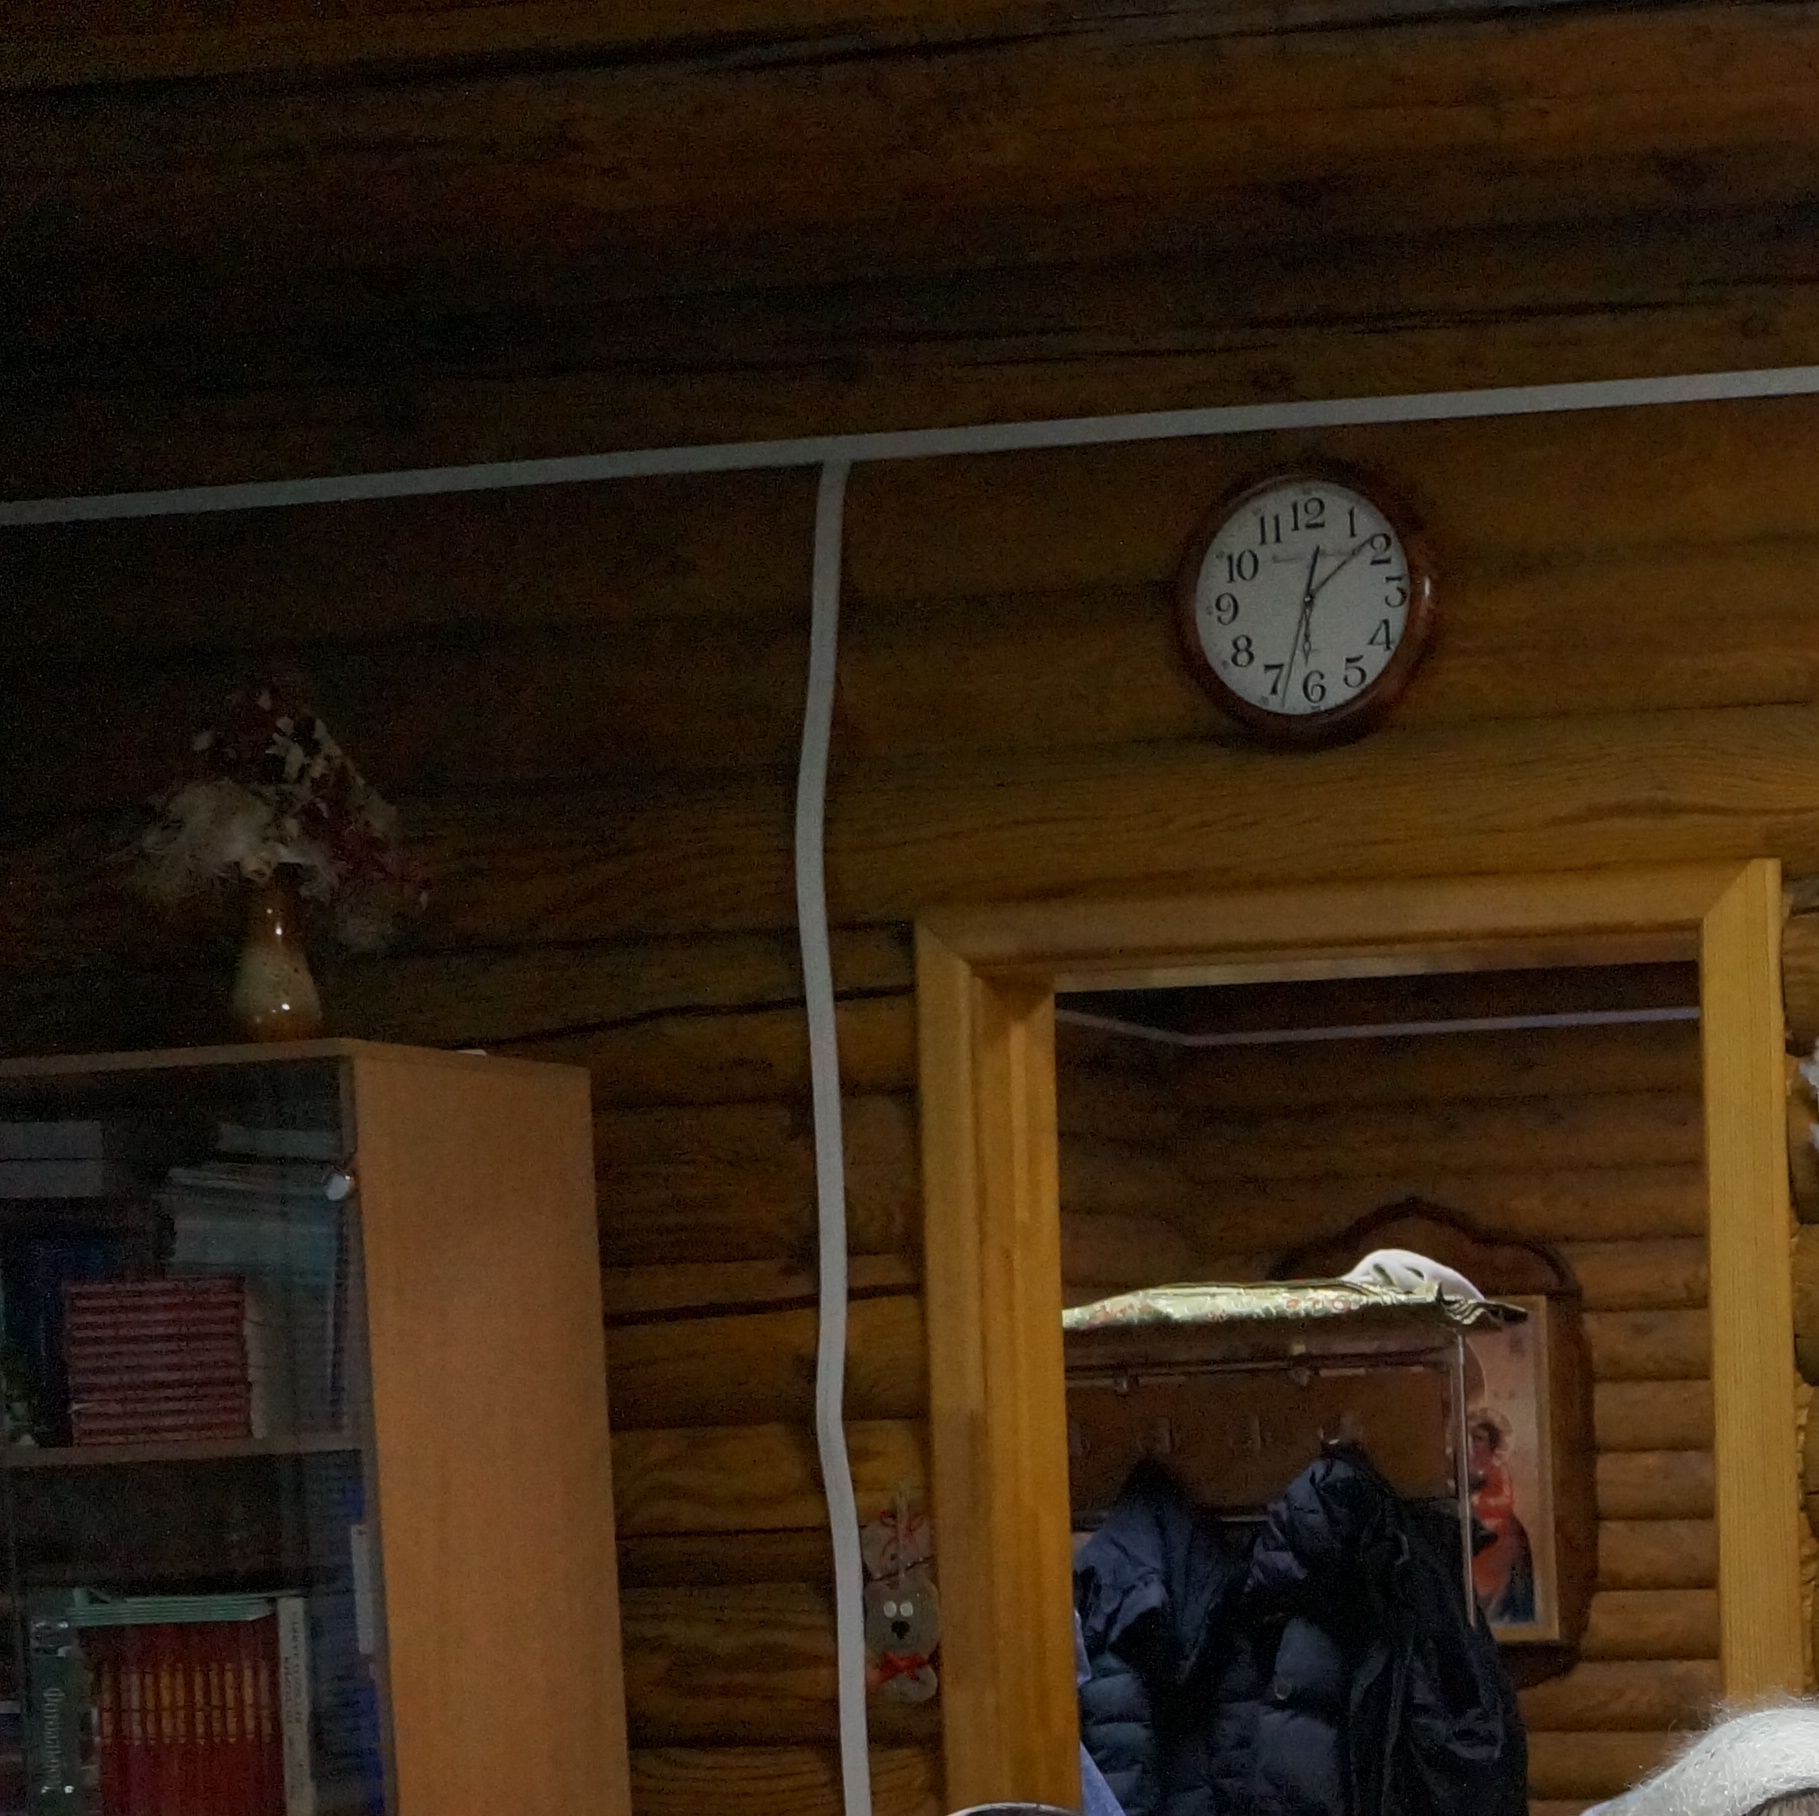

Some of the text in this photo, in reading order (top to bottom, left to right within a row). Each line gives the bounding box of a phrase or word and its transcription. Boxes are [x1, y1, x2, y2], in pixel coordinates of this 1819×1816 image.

[1258, 513, 1282, 545] 11
[1291, 497, 1325, 531] 12
[1348, 506, 1357, 538] 1
[1369, 532, 1392, 566] 2
[1226, 549, 1259, 583] 10
[1384, 576, 1407, 608] 3
[1215, 592, 1239, 626] 9
[1231, 634, 1254, 668] 8
[1367, 618, 1393, 651] 4
[1263, 663, 1284, 695] 7
[1302, 669, 1326, 703] 6
[1343, 655, 1367, 688] 5
